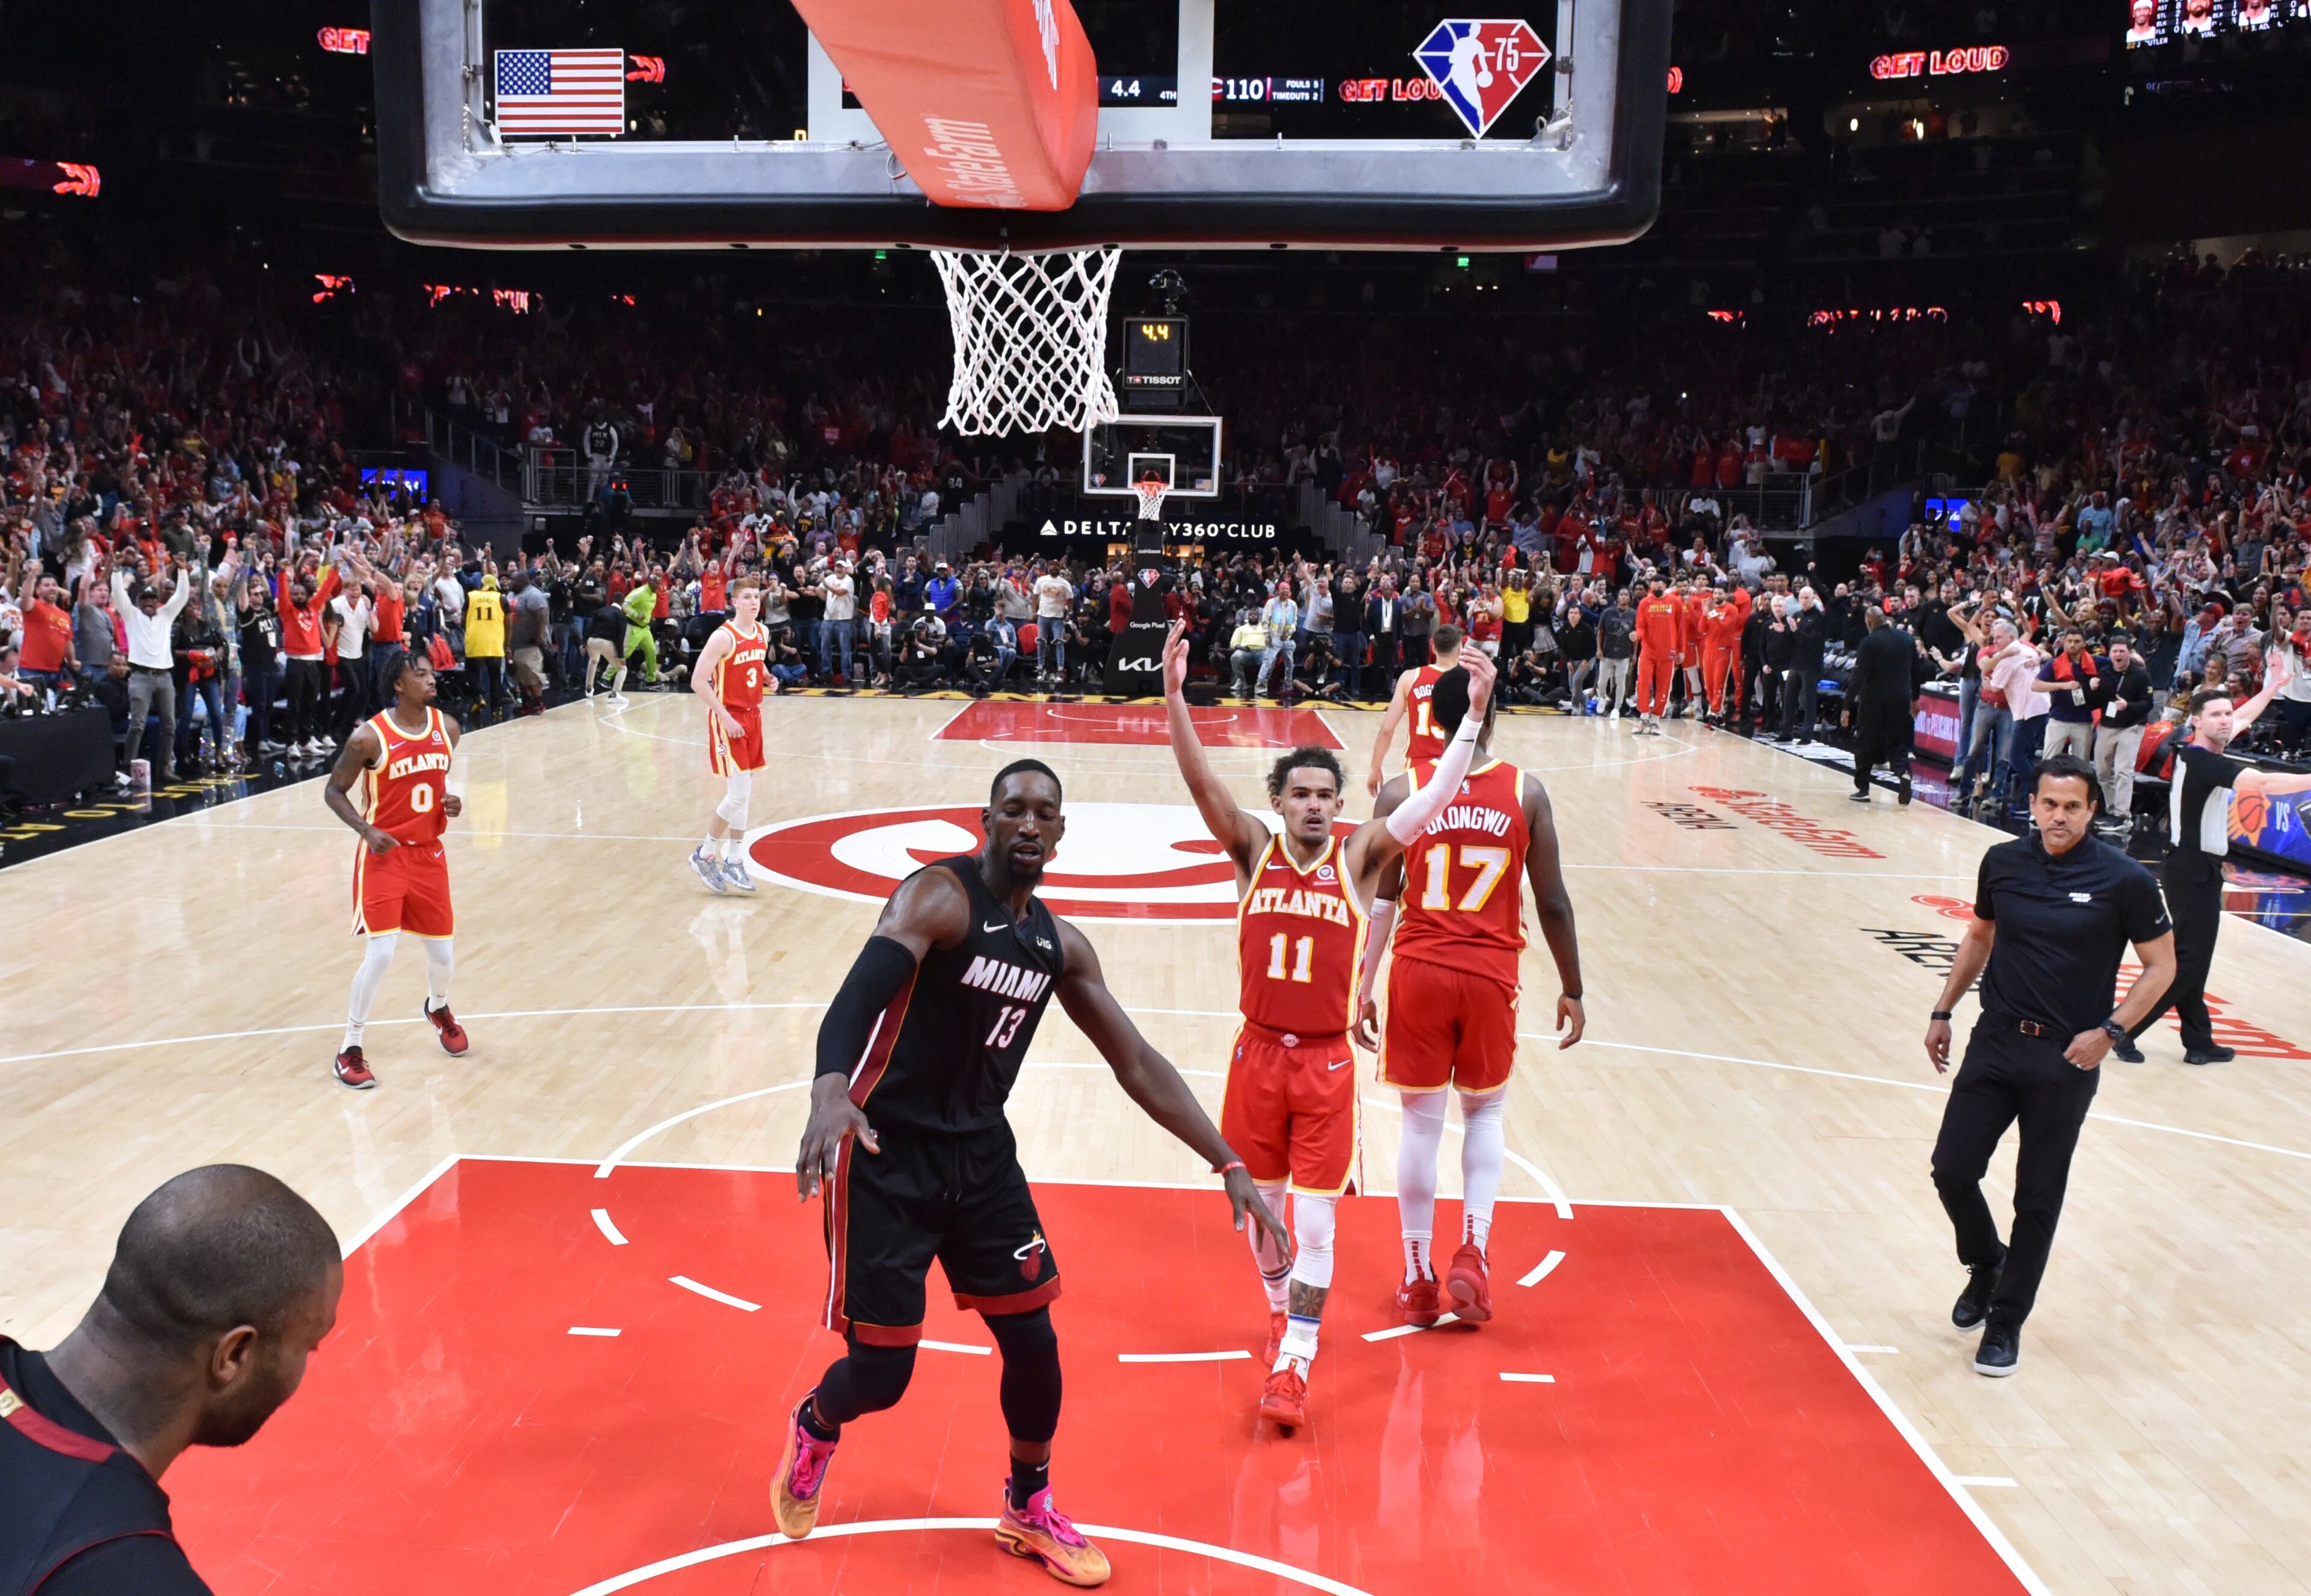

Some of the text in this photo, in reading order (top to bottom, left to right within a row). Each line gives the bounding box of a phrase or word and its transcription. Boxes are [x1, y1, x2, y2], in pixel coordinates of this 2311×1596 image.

[317, 26, 370, 54] GET
[2145, 37, 2168, 46] UTLER
[1494, 37, 1520, 72] 75
[1870, 46, 2009, 79] GET LOUD
[1111, 80, 1140, 97] 4.4
[1160, 91, 1177, 100] 4TH
[1227, 79, 1264, 100] 110
[1272, 92, 1310, 101] TIMEOUTS
[1338, 78, 1447, 102] GET LOU
[1142, 324, 1169, 341] 4.4
[1142, 376, 1181, 385] TISSOT
[475, 607, 494, 621] 11
[746, 667, 758, 688] 3
[1413, 684, 1435, 700] BOG
[410, 782, 433, 813] 0
[1640, 801, 1739, 830] ARENA
[2275, 801, 2291, 833] VS
[1422, 843, 1511, 912] 17
[1248, 888, 1350, 928] ATLANTA
[1267, 932, 1314, 983] 11
[961, 955, 1052, 1003] MIAMI
[985, 1005, 1027, 1048] 13
